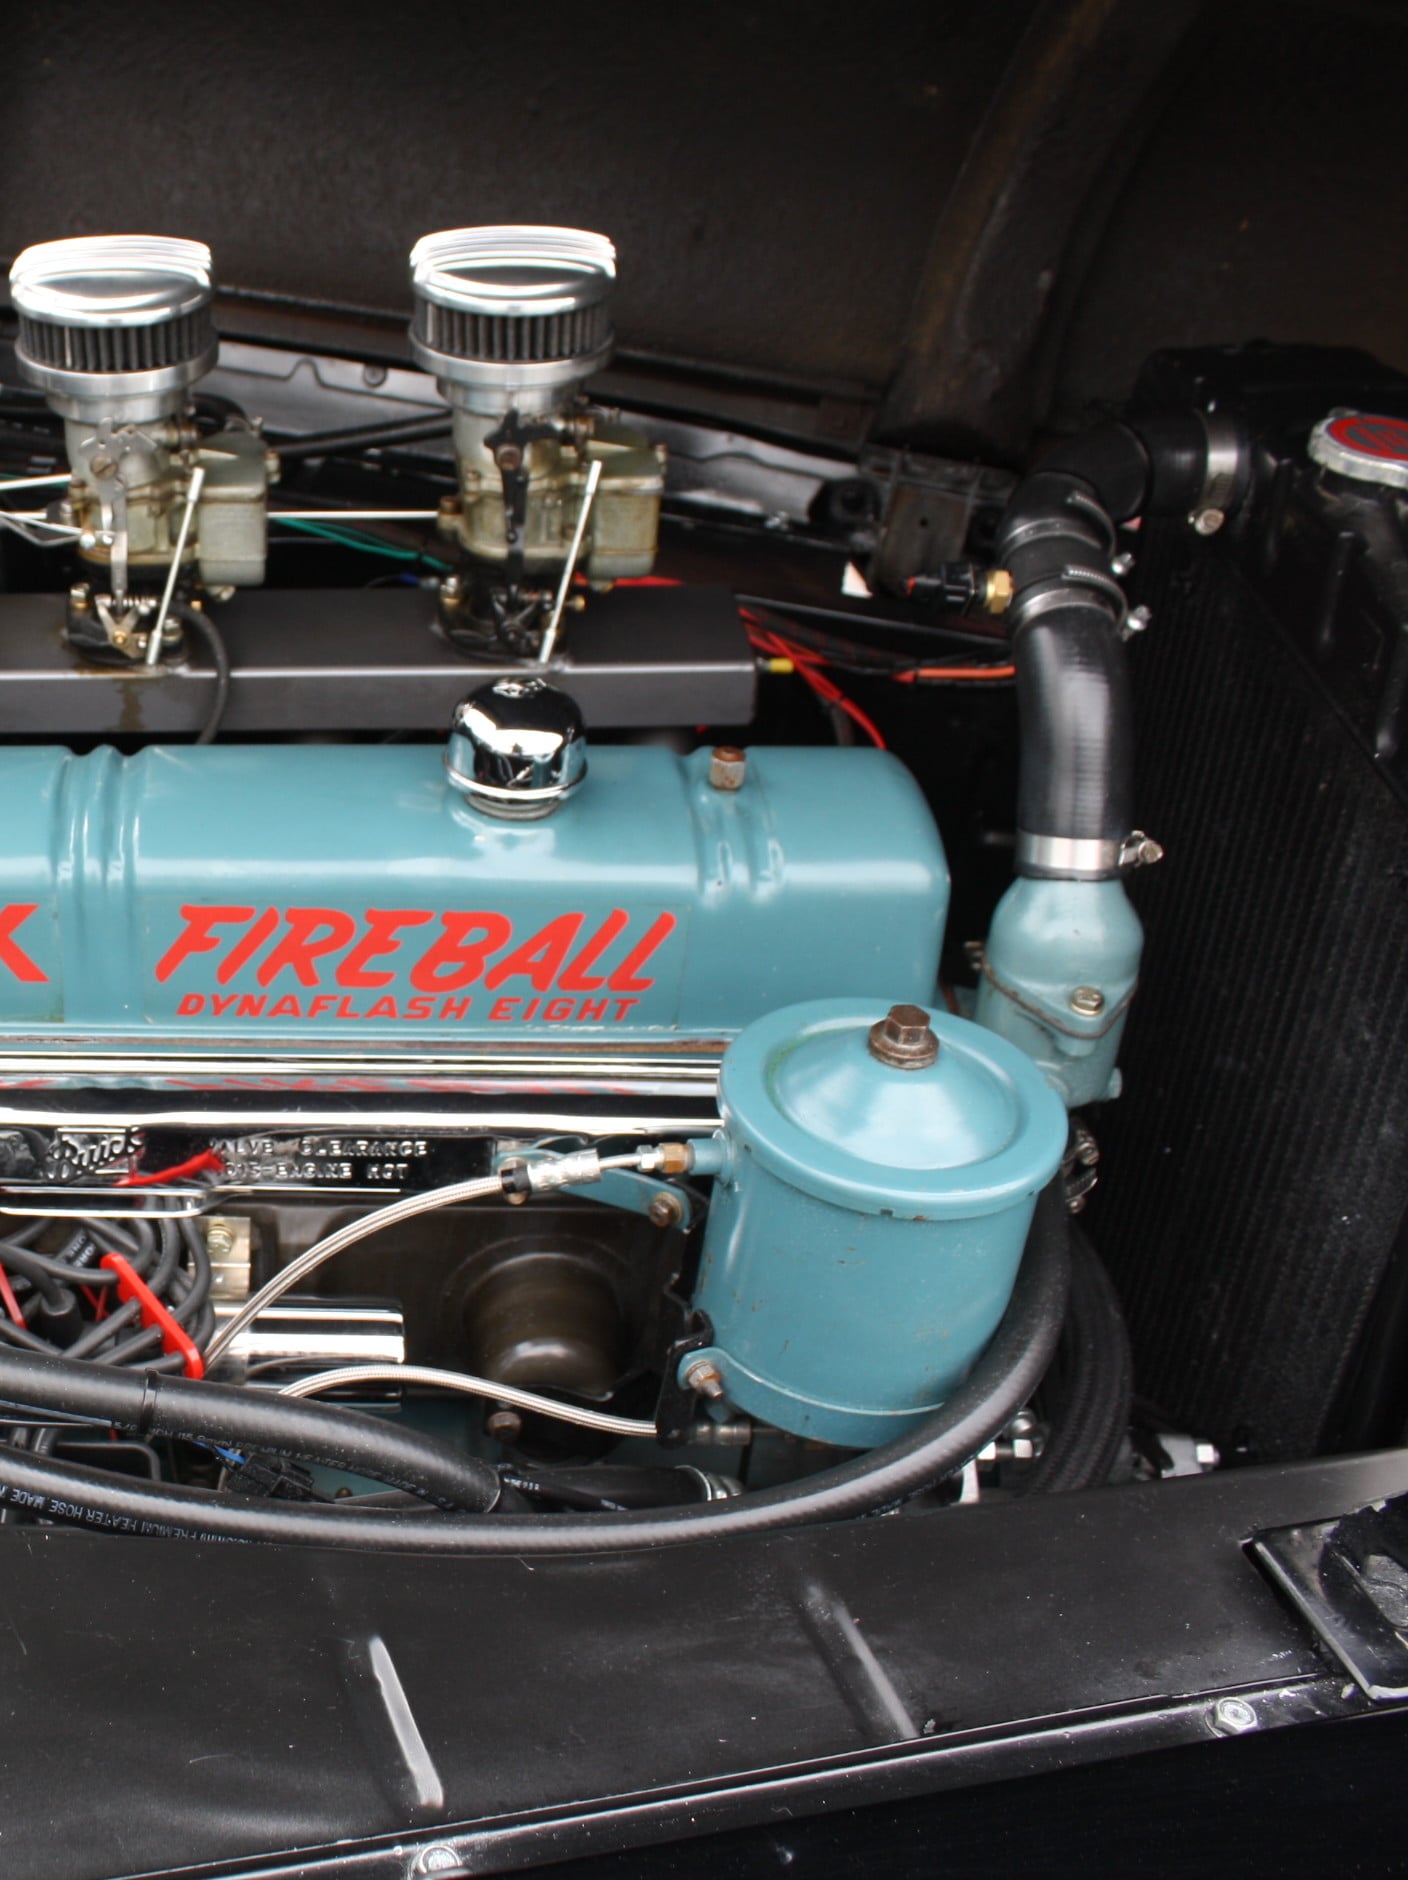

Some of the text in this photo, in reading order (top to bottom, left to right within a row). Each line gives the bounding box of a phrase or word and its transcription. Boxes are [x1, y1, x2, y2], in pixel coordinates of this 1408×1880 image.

[157, 906, 674, 992] FIREBALL
[178, 995, 637, 1020] DYNAFLASH EIGHT
[299, 1139, 428, 1157] CLEARANCE
[366, 1163, 409, 1180] HOT
[11, 1487, 45, 1508] MADE
[49, 1498, 82, 1519] HOSE
[85, 1508, 137, 1531] HEATER
